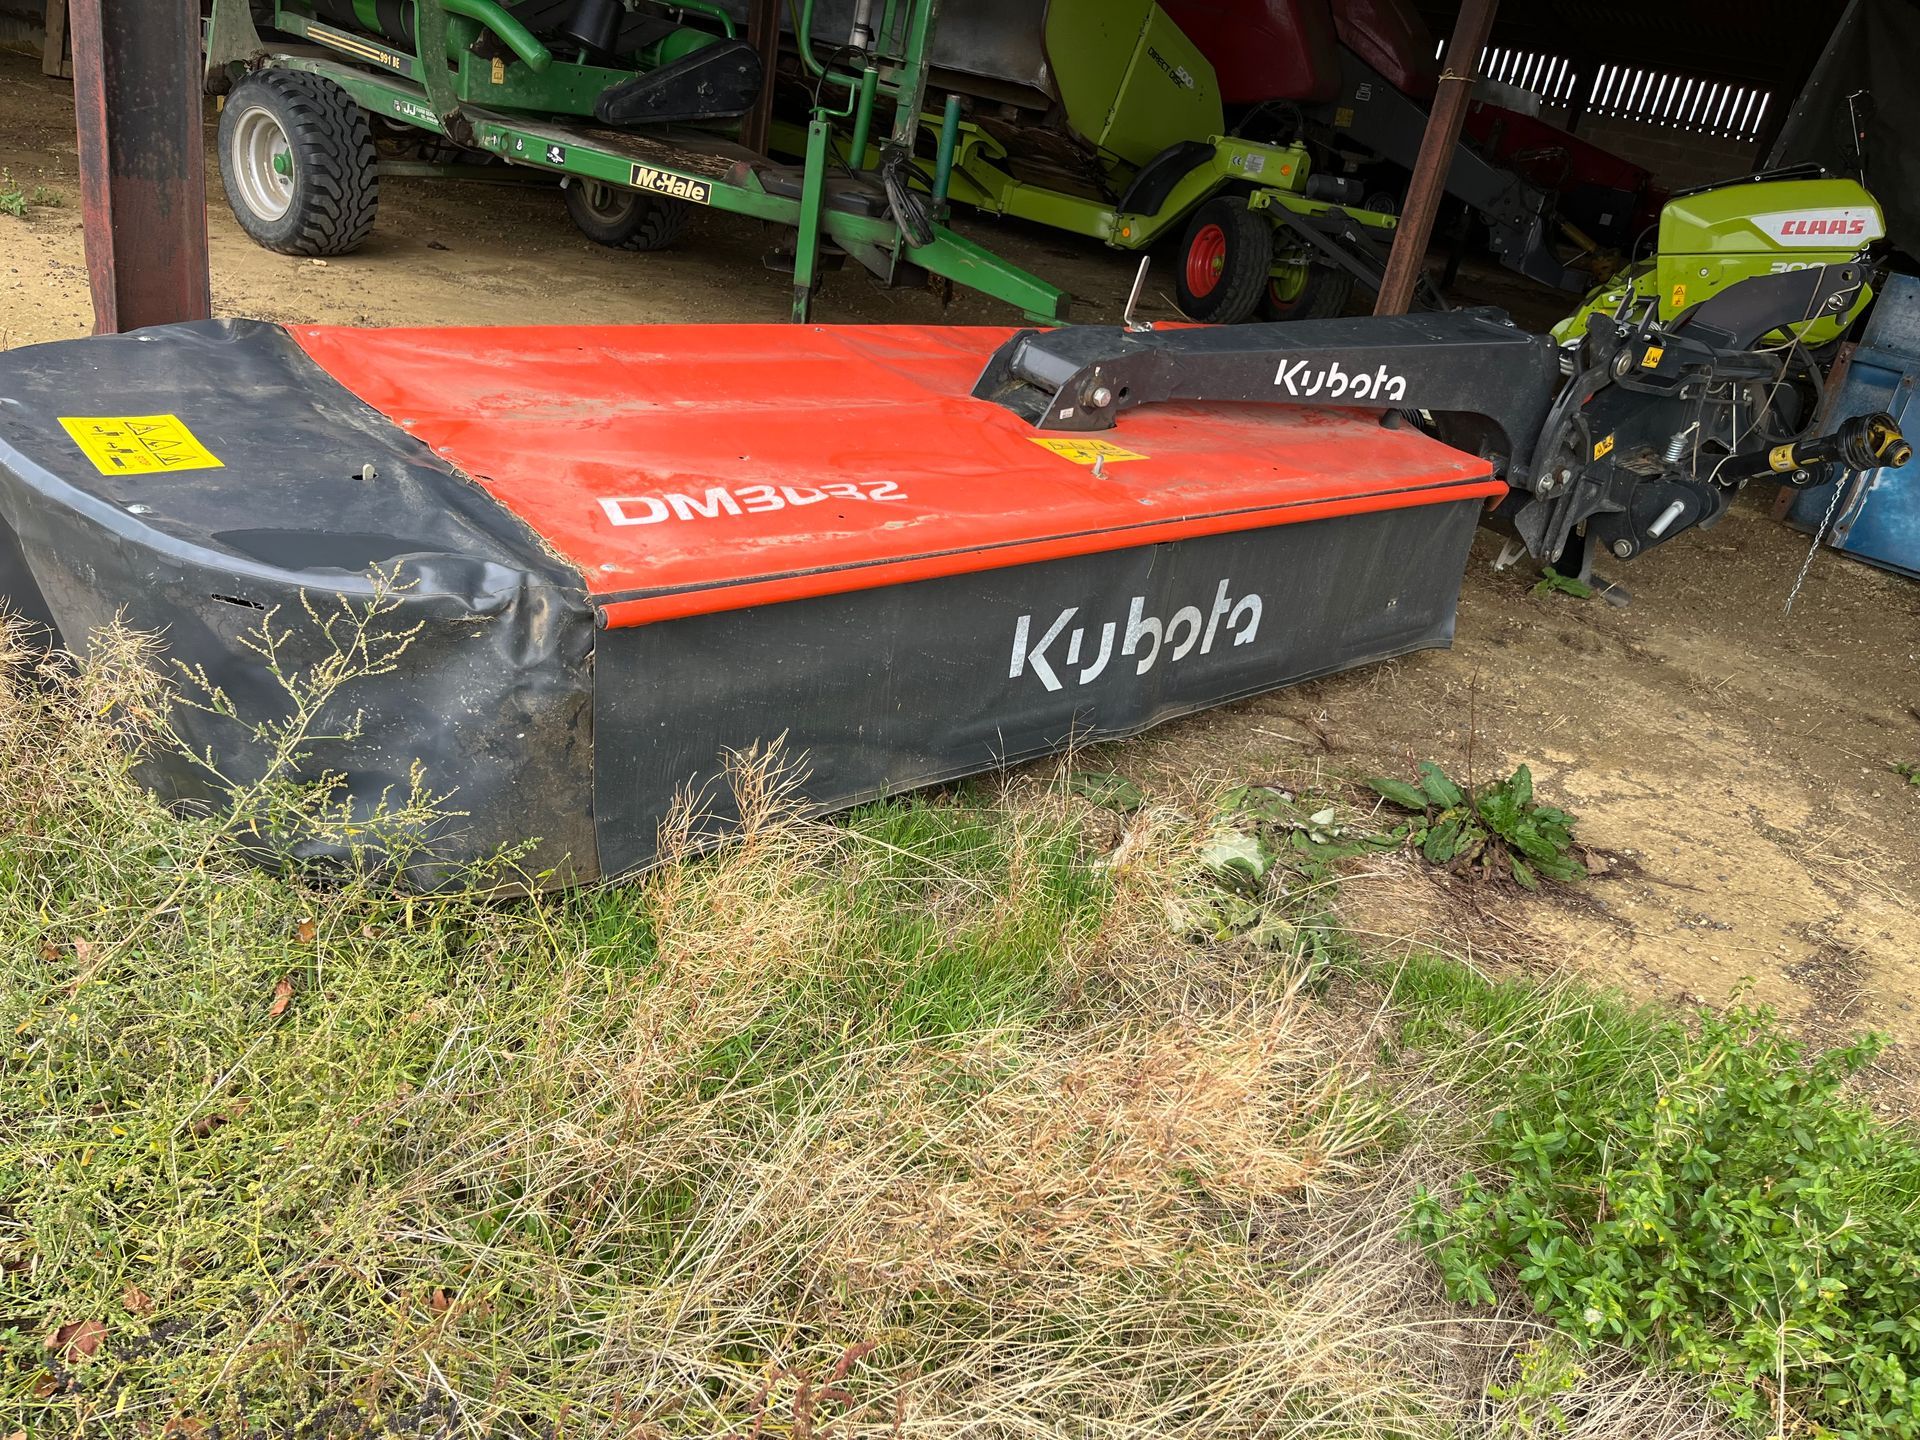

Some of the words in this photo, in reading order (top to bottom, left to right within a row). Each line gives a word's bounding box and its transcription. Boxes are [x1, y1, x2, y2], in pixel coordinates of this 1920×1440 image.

[380, 52, 391, 65] 991
[1147, 46, 1170, 72] DIRECT
[403, 103, 415, 115] JJ
[636, 167, 705, 201] McHale
[1780, 220, 1865, 235] CLAAS
[1273, 359, 1407, 401] Kubota
[596, 481, 908, 526] DM3032
[1008, 578, 1263, 692] Kubota
